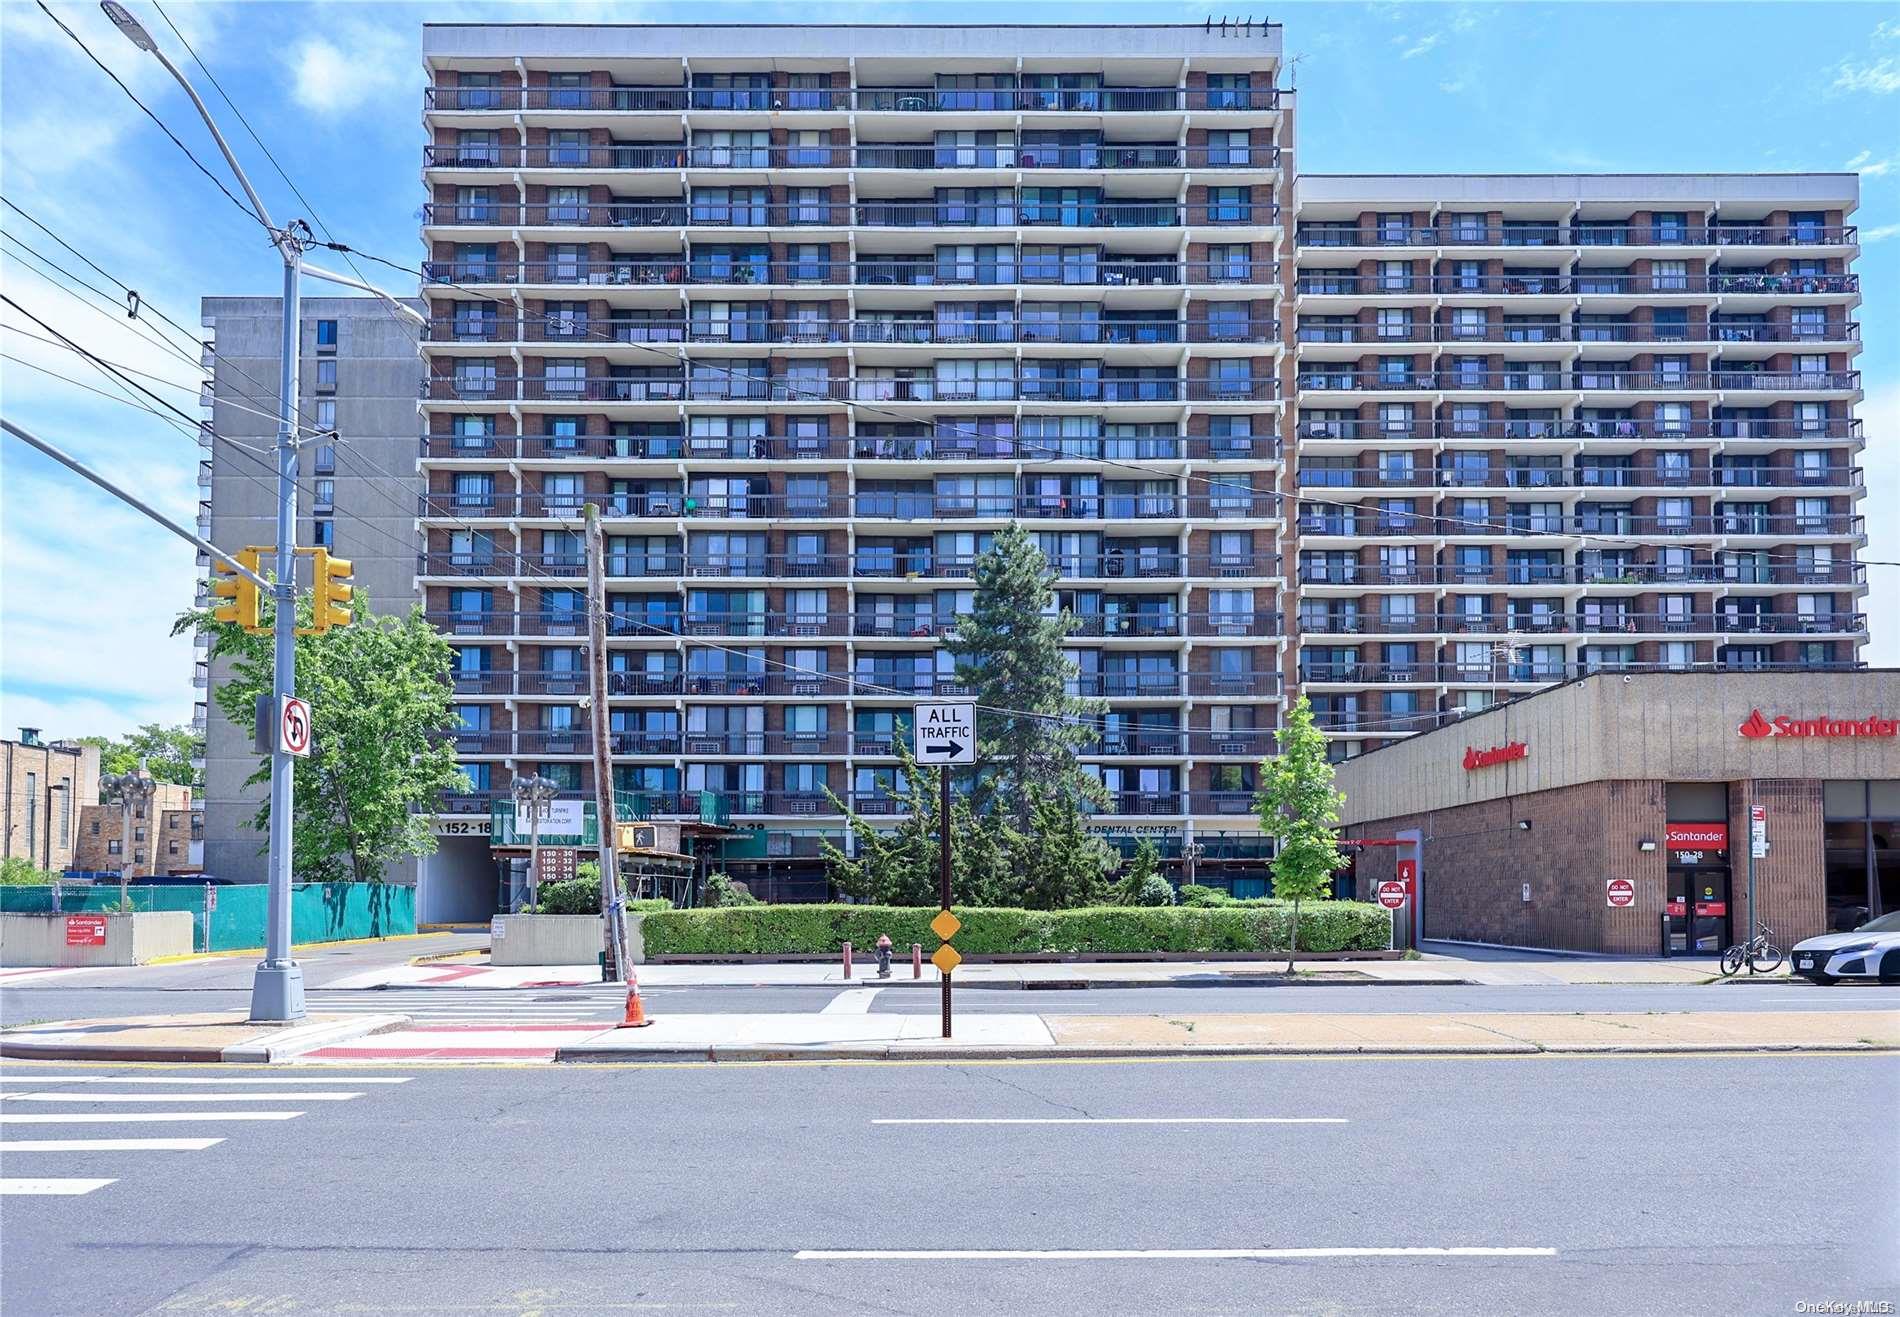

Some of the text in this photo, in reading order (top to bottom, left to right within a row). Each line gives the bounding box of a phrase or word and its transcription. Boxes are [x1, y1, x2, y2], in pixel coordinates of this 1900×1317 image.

[929, 708, 962, 723] ALL
[920, 725, 970, 739] TRAFFIC
[1774, 714, 1900, 737] Santander
[1475, 742, 1526, 768] Santander
[1094, 825, 1133, 834] DENTAL
[1136, 825, 1178, 834] CENTER
[1670, 831, 1724, 841] Santander
[1675, 850, 1704, 859] 150-28
